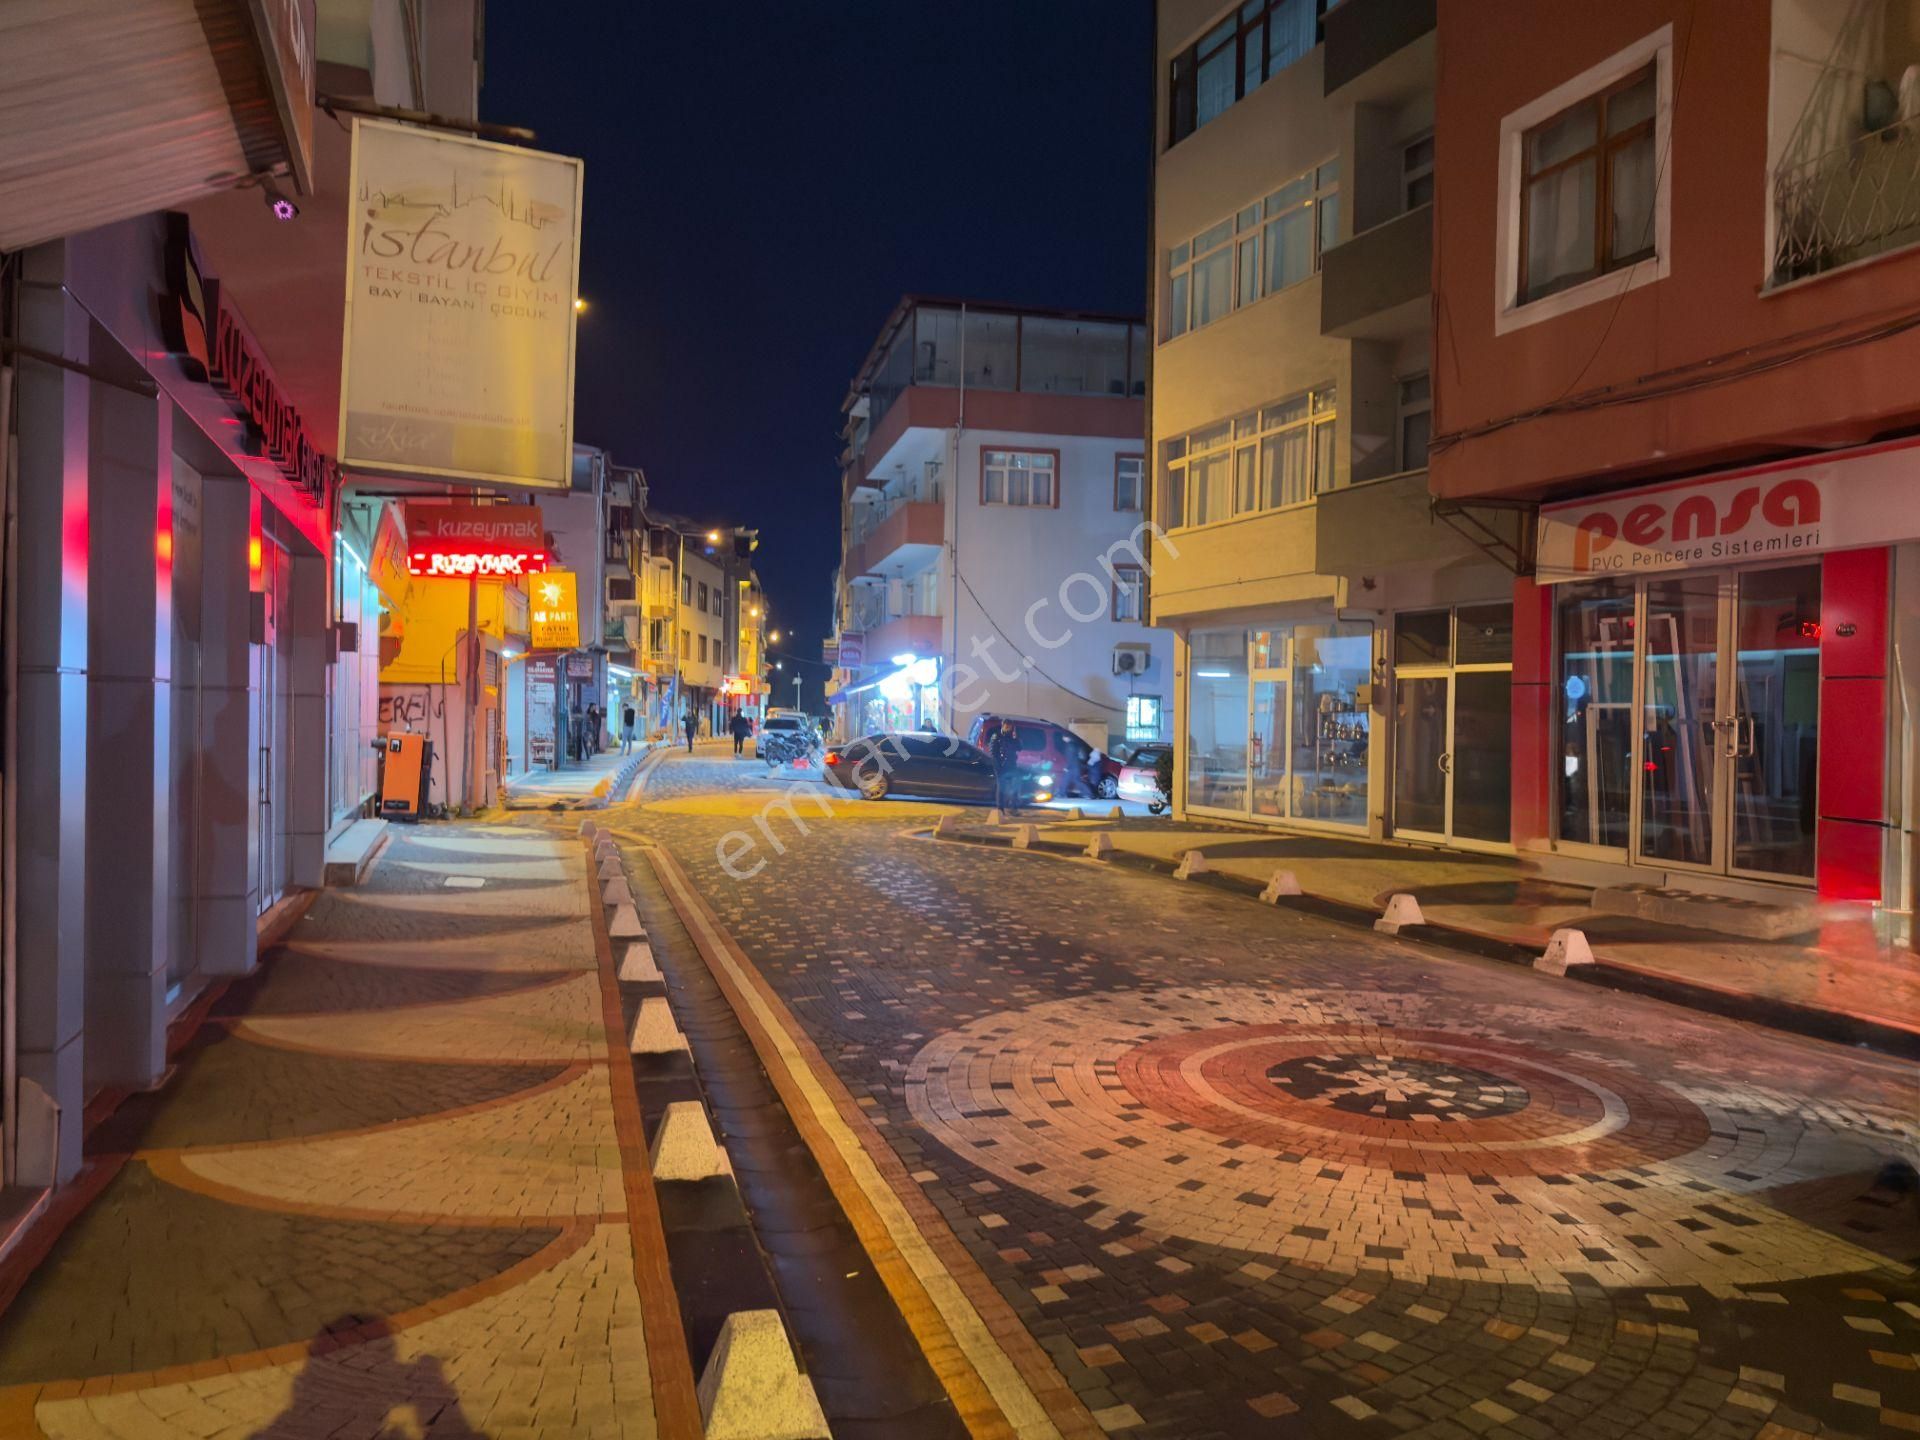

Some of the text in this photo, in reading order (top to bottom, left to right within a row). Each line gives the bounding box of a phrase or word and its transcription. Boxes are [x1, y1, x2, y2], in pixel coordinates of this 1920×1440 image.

[362, 209, 563, 283] istanbul
[369, 286, 402, 300] BAY
[418, 294, 475, 311] BAYAN
[437, 519, 539, 541] kuzeymak
[1573, 479, 1821, 572] pensa
[1591, 530, 1820, 572] PVC Pencere Sistemleri
